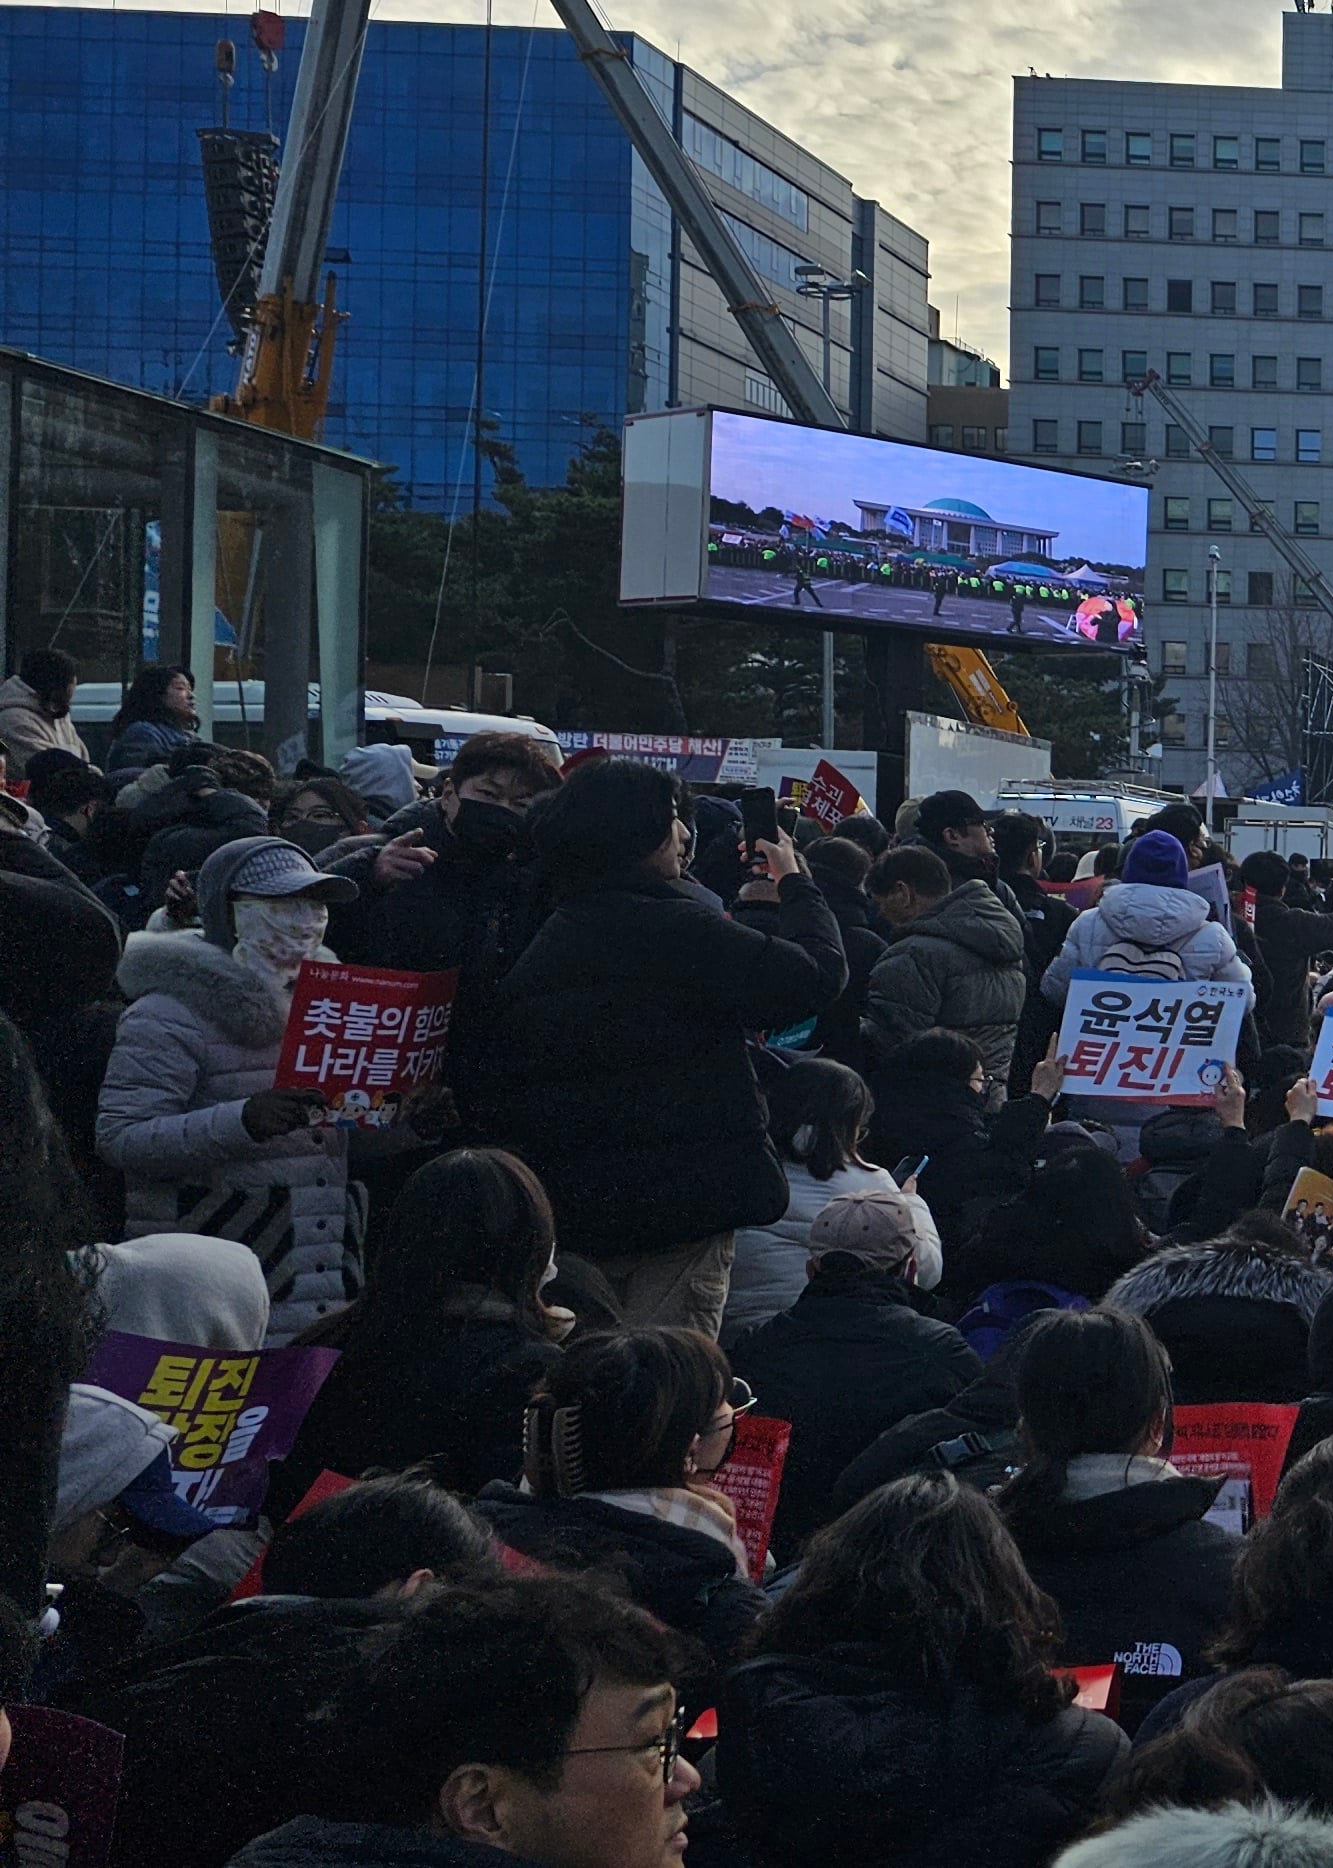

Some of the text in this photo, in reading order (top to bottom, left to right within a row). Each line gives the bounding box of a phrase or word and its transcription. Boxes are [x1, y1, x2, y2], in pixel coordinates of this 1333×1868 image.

[558, 732, 722, 757] 방탄 더불어민주당 해산!
[812, 776, 844, 807] 수괴
[304, 998, 413, 1044] 촛불의
[1080, 990, 1225, 1047] 윤석열
[295, 1043, 400, 1086] 나라를
[1063, 1039, 1186, 1093] 퇴진!
[138, 1355, 261, 1412] 퇴진
[1113, 1651, 1158, 1664] NORTH
[1134, 1642, 1161, 1654] THE
[1124, 1663, 1158, 1675] FACE
